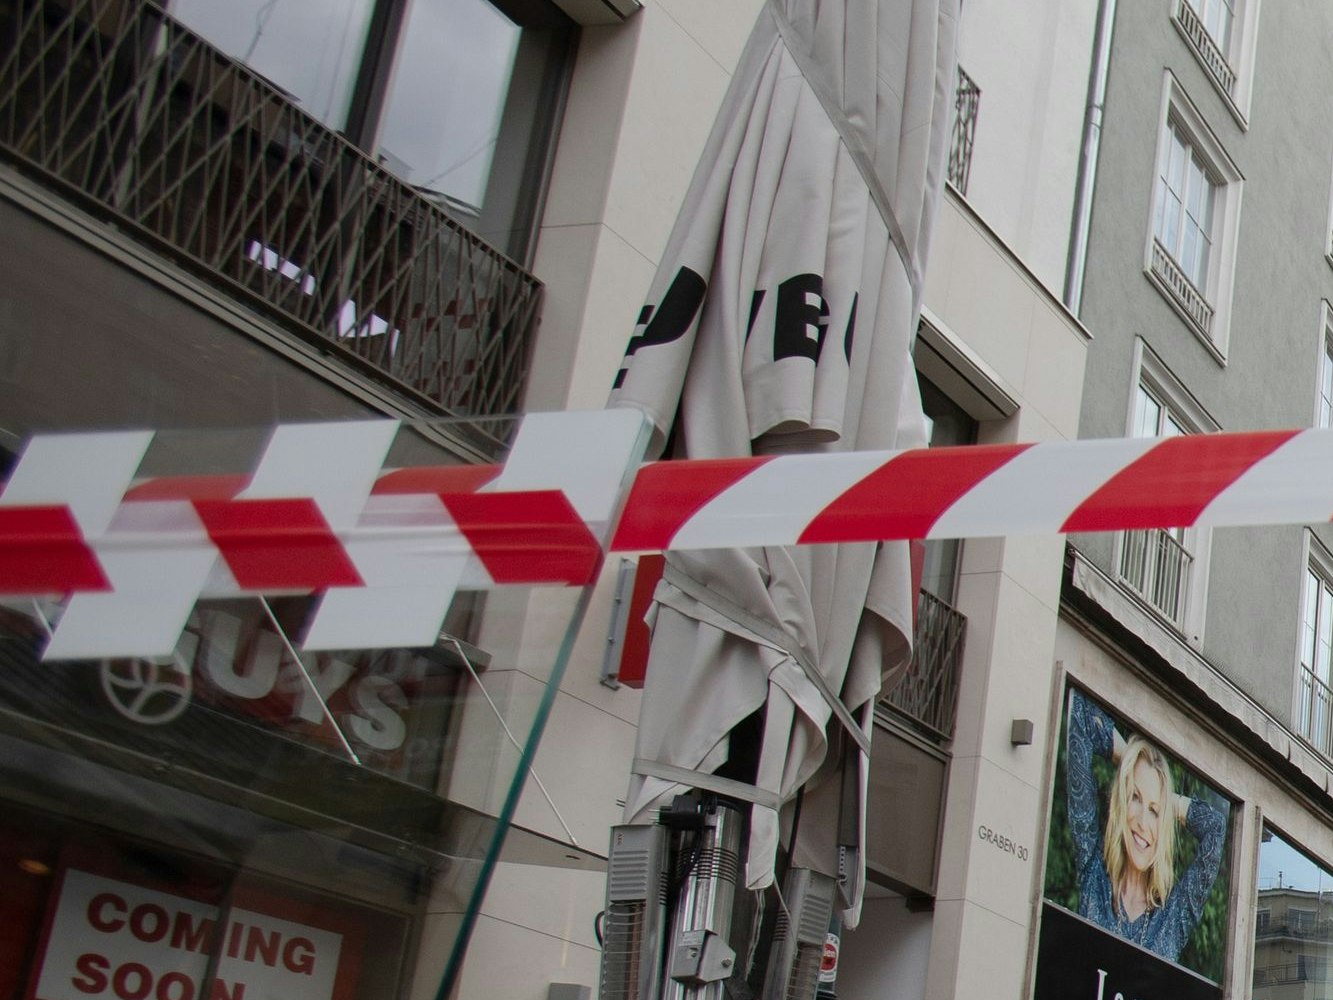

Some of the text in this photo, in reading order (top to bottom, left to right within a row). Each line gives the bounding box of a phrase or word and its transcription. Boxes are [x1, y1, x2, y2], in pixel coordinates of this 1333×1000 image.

[978, 825, 1029, 861] GRABEN 30
[86, 892, 316, 976] COMING
